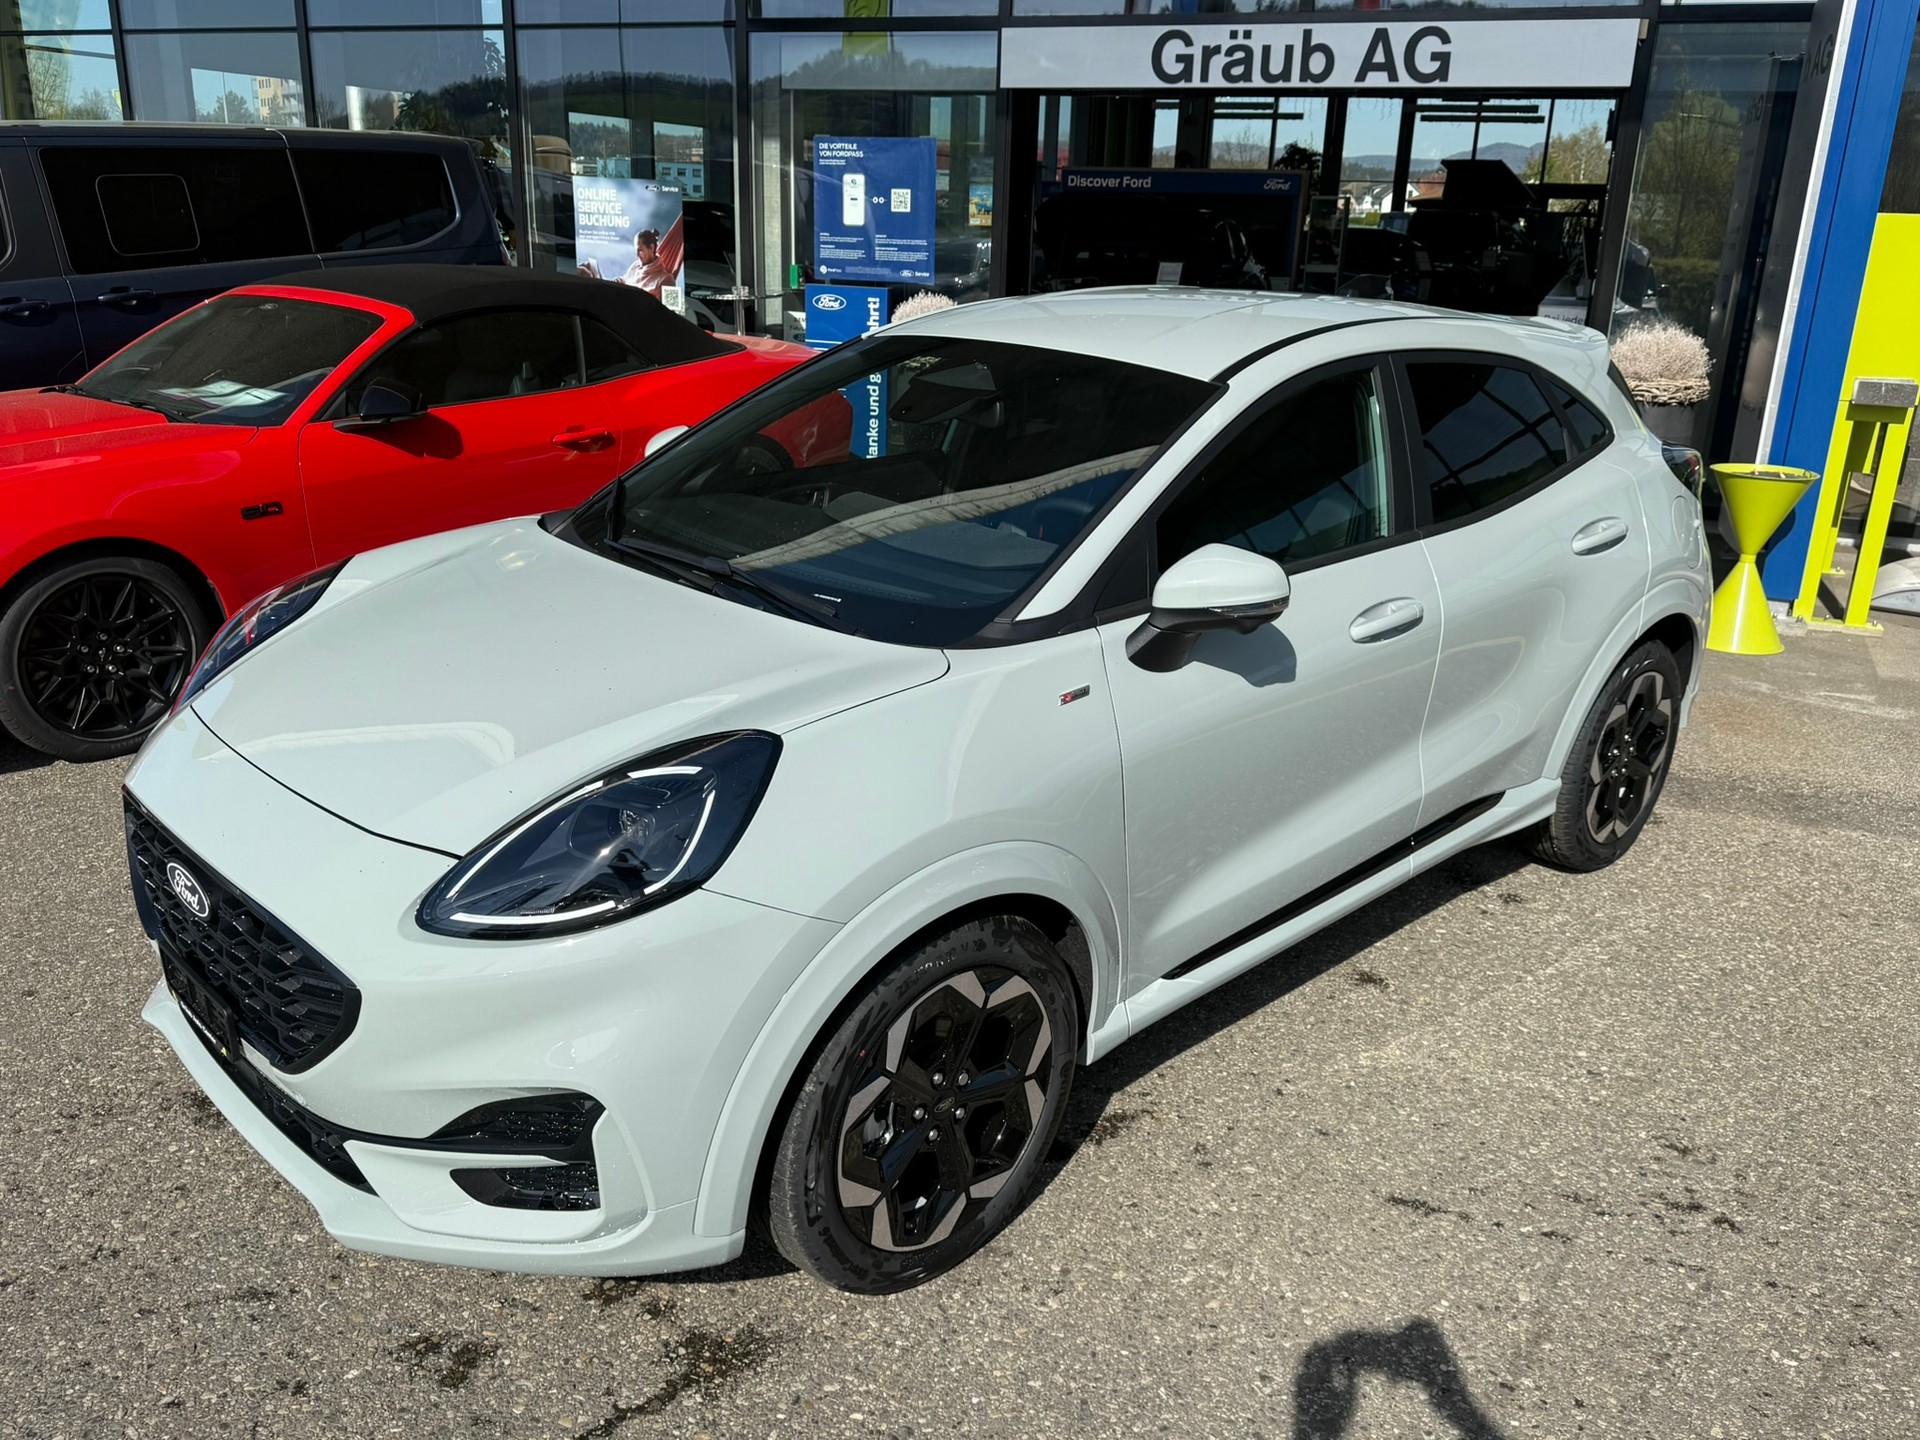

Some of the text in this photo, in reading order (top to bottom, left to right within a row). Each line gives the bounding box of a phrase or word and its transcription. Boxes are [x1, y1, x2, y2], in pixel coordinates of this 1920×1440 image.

[1151, 25, 1452, 85] Gräub AG
[1068, 175, 1151, 188] Discover Ford
[1263, 178, 1291, 190] Ford
[577, 187, 617, 200] ONLINE
[578, 201, 622, 214] SERVICE
[579, 213, 630, 228] BUCHUNG
[817, 295, 842, 309] Ford
[866, 385, 880, 416] und
[172, 867, 203, 912] Ford
